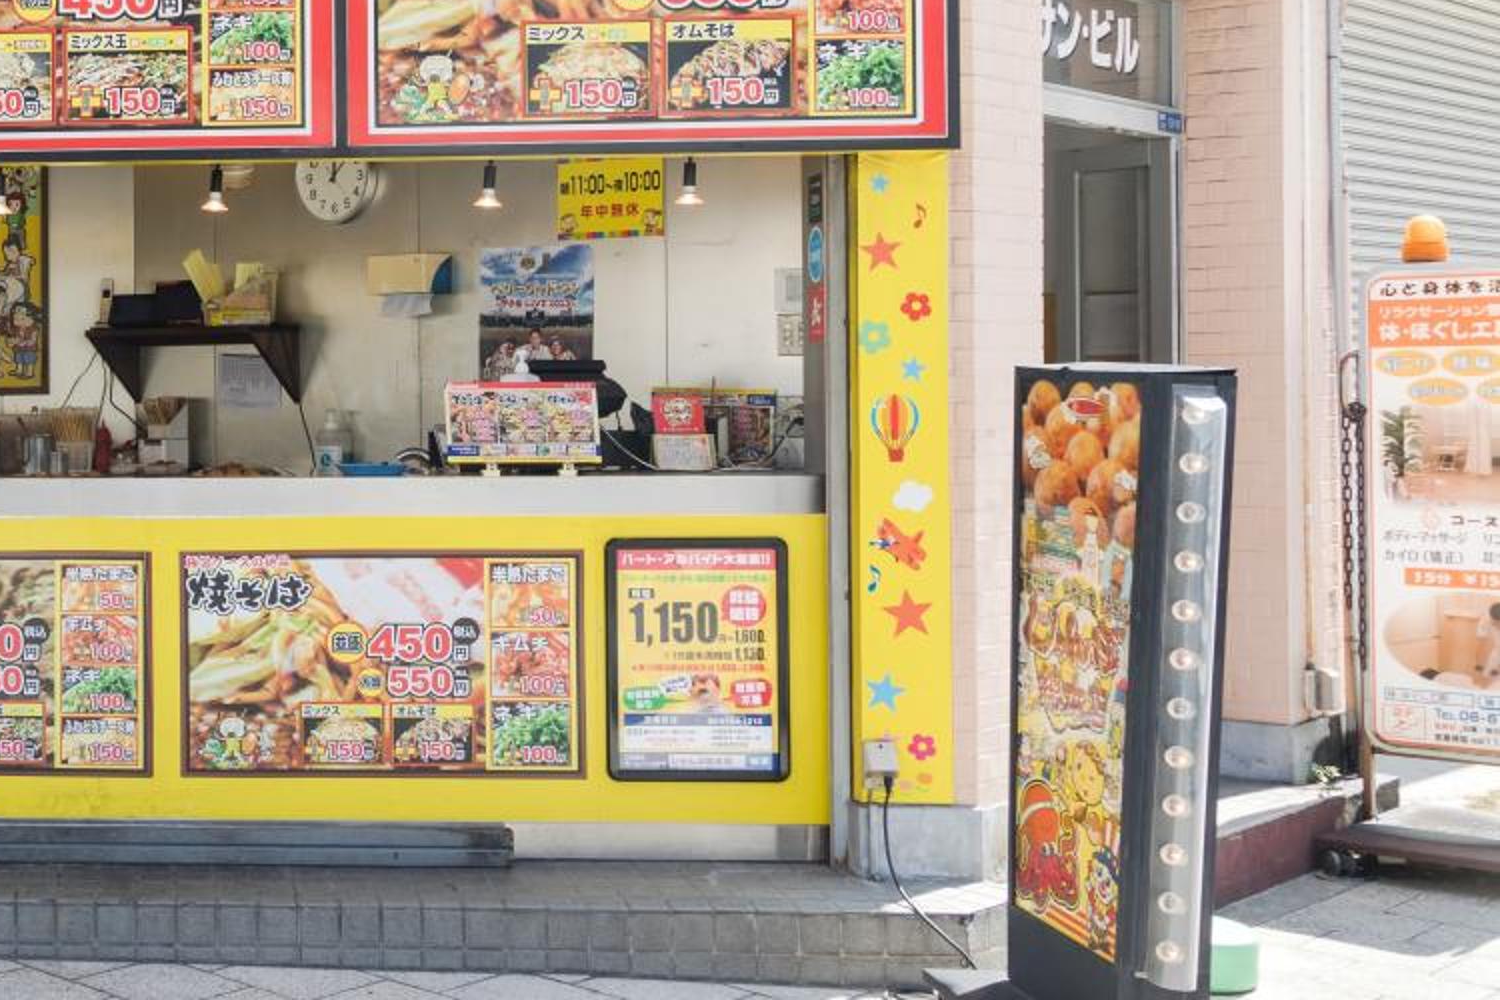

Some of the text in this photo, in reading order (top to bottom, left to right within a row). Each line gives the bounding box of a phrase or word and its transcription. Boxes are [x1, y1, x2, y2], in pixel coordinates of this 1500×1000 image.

[848, 11, 887, 30] 100
[70, 35, 128, 49] ミックス玉
[528, 26, 586, 41] ミックス
[243, 42, 280, 61] 100
[566, 80, 622, 107] 150
[707, 77, 764, 104] 150
[850, 88, 889, 105] 100
[106, 87, 160, 115] 150
[242, 99, 279, 118] 150
[186, 569, 311, 612] 焼そば
[99, 592, 124, 609] 50
[629, 600, 719, 647] 1,150
[90, 643, 124, 660] 100
[367, 625, 453, 663] 450
[454, 645, 469, 661] 円
[25, 645, 41, 661] 円
[26, 679, 40, 694] 円
[388, 666, 469, 696] 550 円
[519, 676, 555, 694] 100
[89, 693, 124, 710] 100
[90, 744, 124, 761] 150
[327, 742, 365, 759] 150
[419, 742, 455, 759] 150
[521, 746, 557, 763] 100
